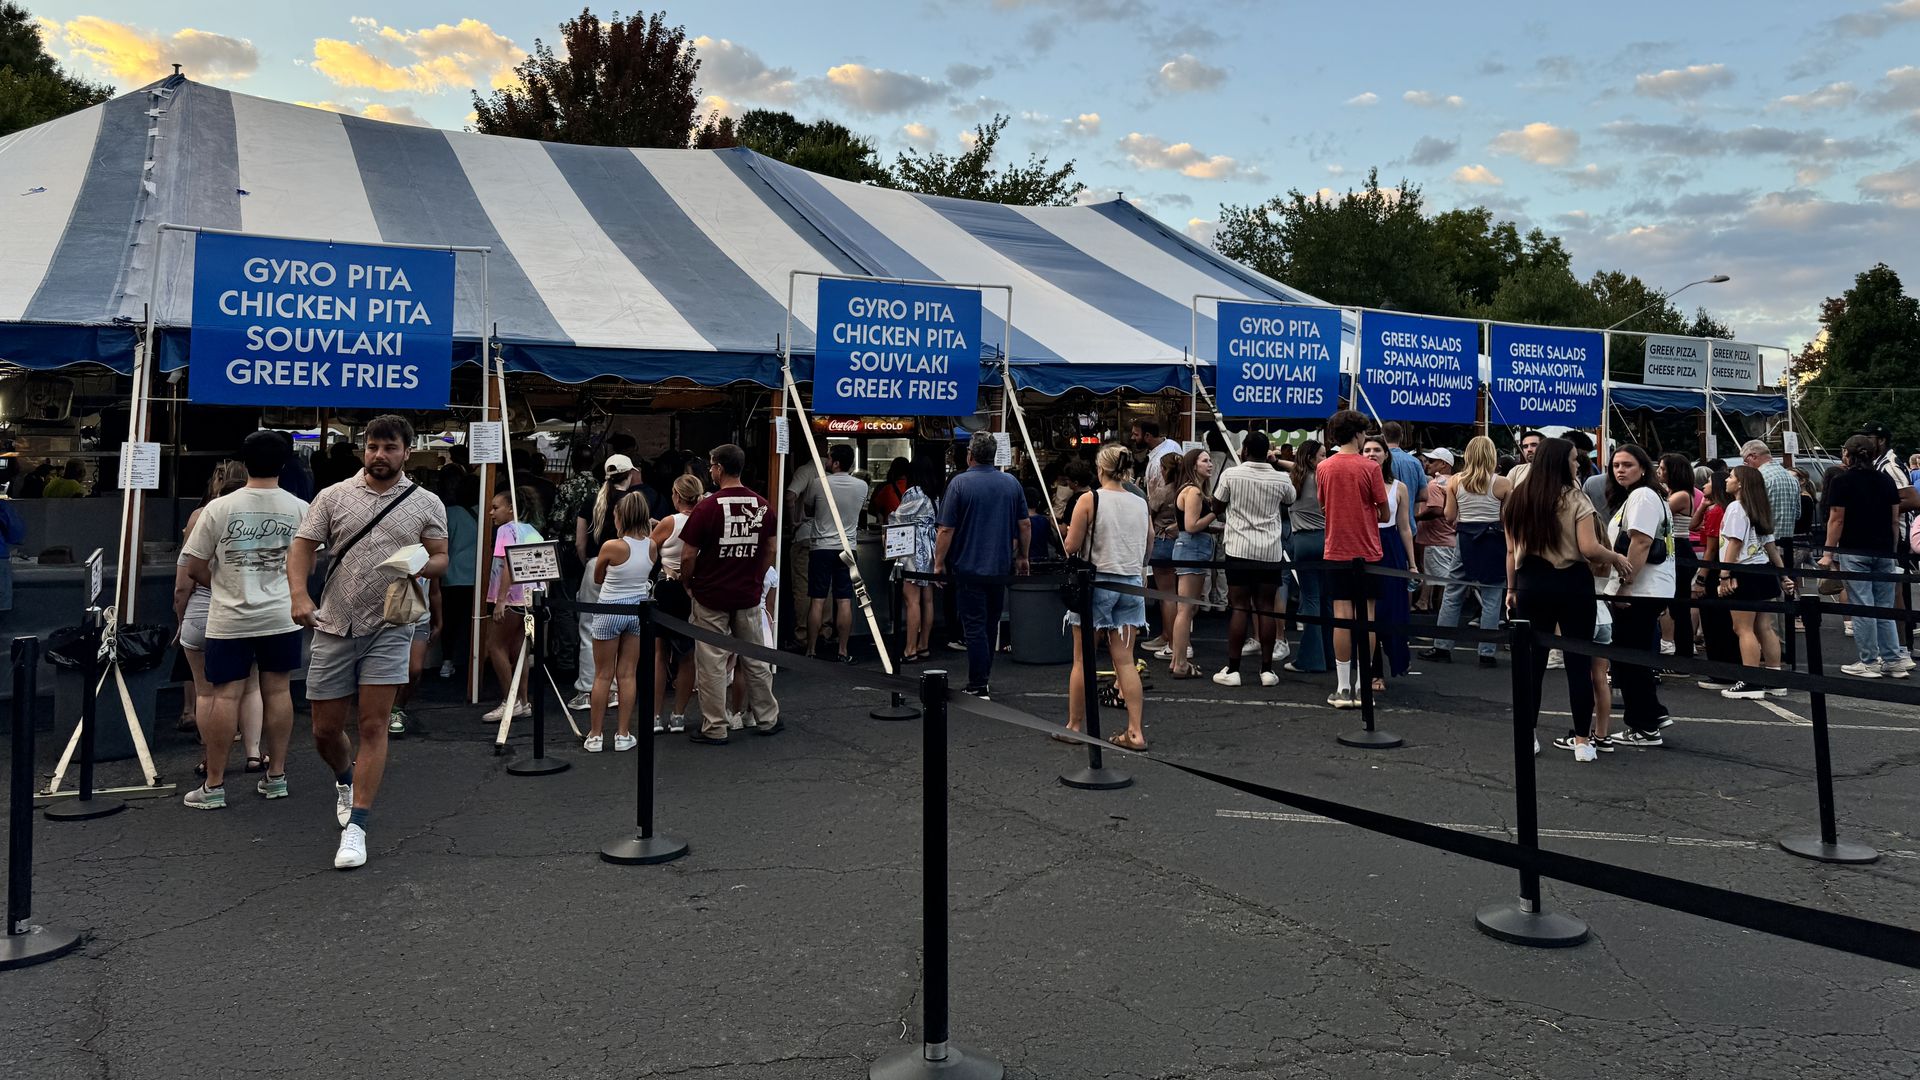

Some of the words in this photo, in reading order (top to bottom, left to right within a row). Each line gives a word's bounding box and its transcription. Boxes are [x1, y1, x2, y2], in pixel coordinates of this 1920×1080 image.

[244, 258, 336, 286] GYRO
[348, 264, 411, 292] PITA
[219, 290, 356, 321] CHICKEN
[369, 299, 431, 325] PITA
[848, 297, 907, 319] GYRO
[914, 302, 954, 323] PITA
[833, 323, 919, 346] CHICKEN
[927, 329, 967, 349] PITA
[1240, 317, 1284, 336] GYRO
[1290, 320, 1320, 338] PITA
[246, 326, 402, 356] SOUVLAKI
[1229, 339, 1294, 358] CHICKEN
[1300, 343, 1330, 360] PITA
[1381, 331, 1418, 348] GREEK
[1421, 335, 1462, 352] SALADS
[1650, 345, 1674, 356] GREEK
[1677, 347, 1696, 357] PIZZA
[850, 351, 948, 374] SOUVLAKI
[1384, 351, 1460, 370] SPANAKOPITA
[1510, 343, 1544, 358] GREEK
[1547, 346, 1586, 361] SALADS
[1713, 348, 1733, 359] GREEK
[1735, 351, 1750, 360] PIZZA
[226, 359, 331, 386] GREEK
[341, 363, 418, 389] FRIES
[1242, 363, 1316, 382] SOUVLAKI
[1366, 369, 1419, 386] TIROPITA
[1429, 374, 1472, 390] HUMMUS
[1512, 361, 1585, 378] SPANAKOPITA
[1649, 364, 1674, 375] CHEESE
[1677, 367, 1696, 377] PIZZA
[1712, 367, 1733, 378] CHEESE
[1735, 369, 1751, 379] PIZZA
[836, 378, 903, 399] GREEK
[909, 380, 958, 400] FRIES
[1233, 385, 1282, 403] GREEK
[1286, 387, 1323, 404] FRIES
[1497, 378, 1546, 394] TIROPITA
[1556, 382, 1597, 396] HUMMUS
[1391, 390, 1451, 407] DOLMADES
[1521, 397, 1576, 412] DOLMADES
[220, 520, 258, 545] Buy
